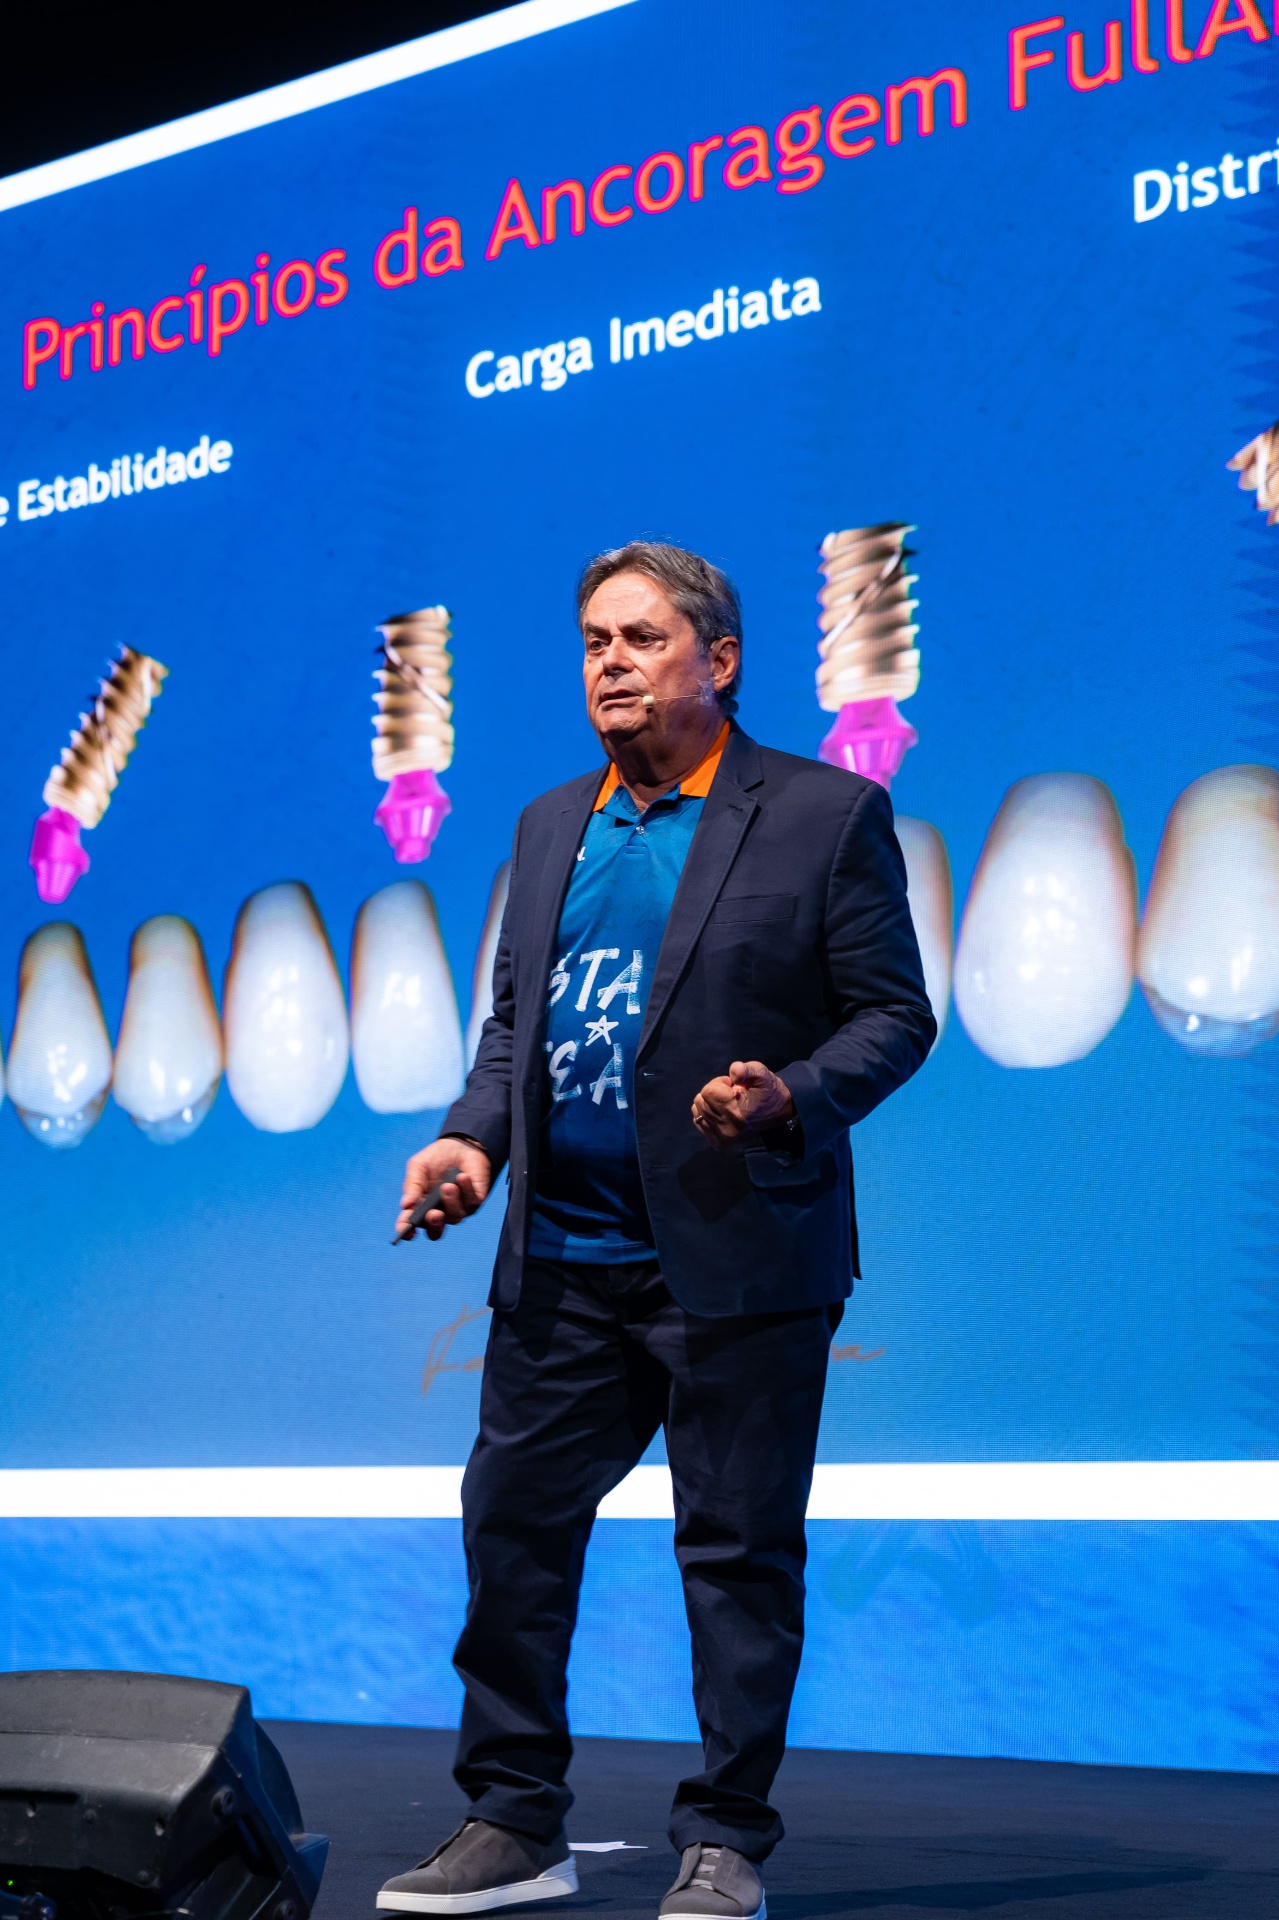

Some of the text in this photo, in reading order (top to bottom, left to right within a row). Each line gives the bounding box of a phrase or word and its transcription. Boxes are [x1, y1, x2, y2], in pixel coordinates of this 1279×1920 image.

[22, 0, 1279, 391] Princípios da Ancoragem FullA
[465, 277, 822, 399] Carga Imediata
[18, 435, 233, 521] Estabilidade
